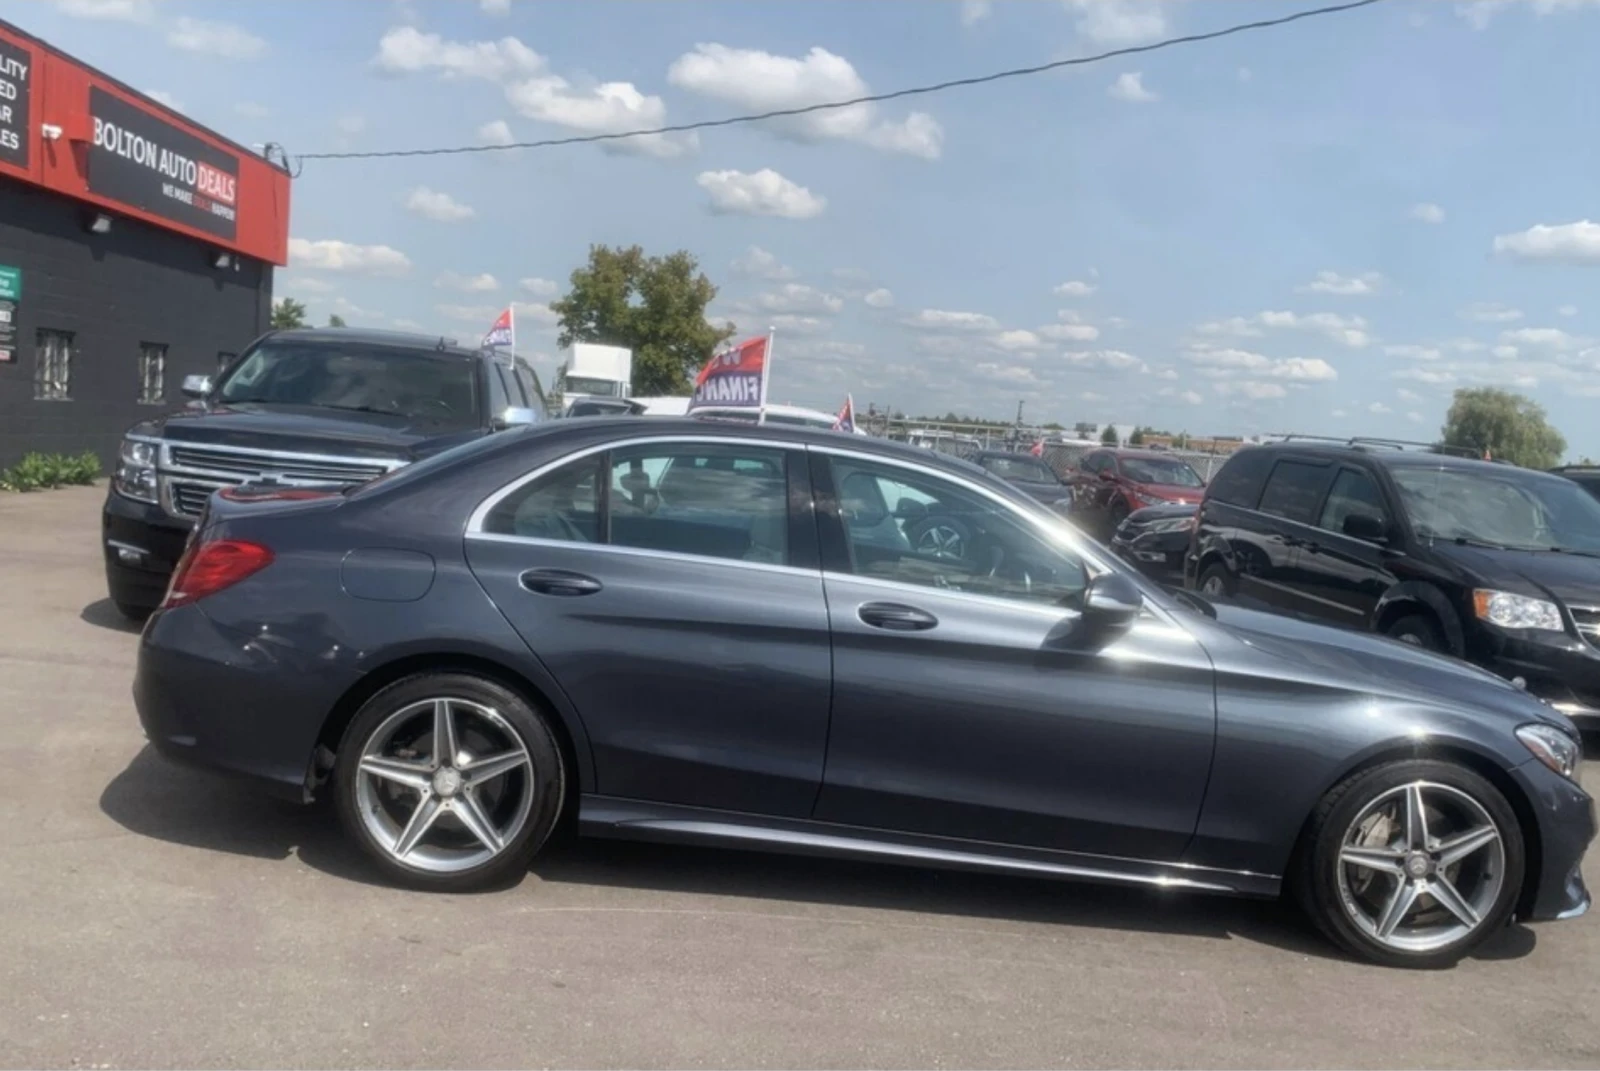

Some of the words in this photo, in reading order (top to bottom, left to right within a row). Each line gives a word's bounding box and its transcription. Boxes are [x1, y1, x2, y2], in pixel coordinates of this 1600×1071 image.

[0, 129, 19, 149] ES
[92, 115, 157, 169] BOLTON
[158, 148, 197, 185] AUTO
[197, 164, 235, 203] DEALS
